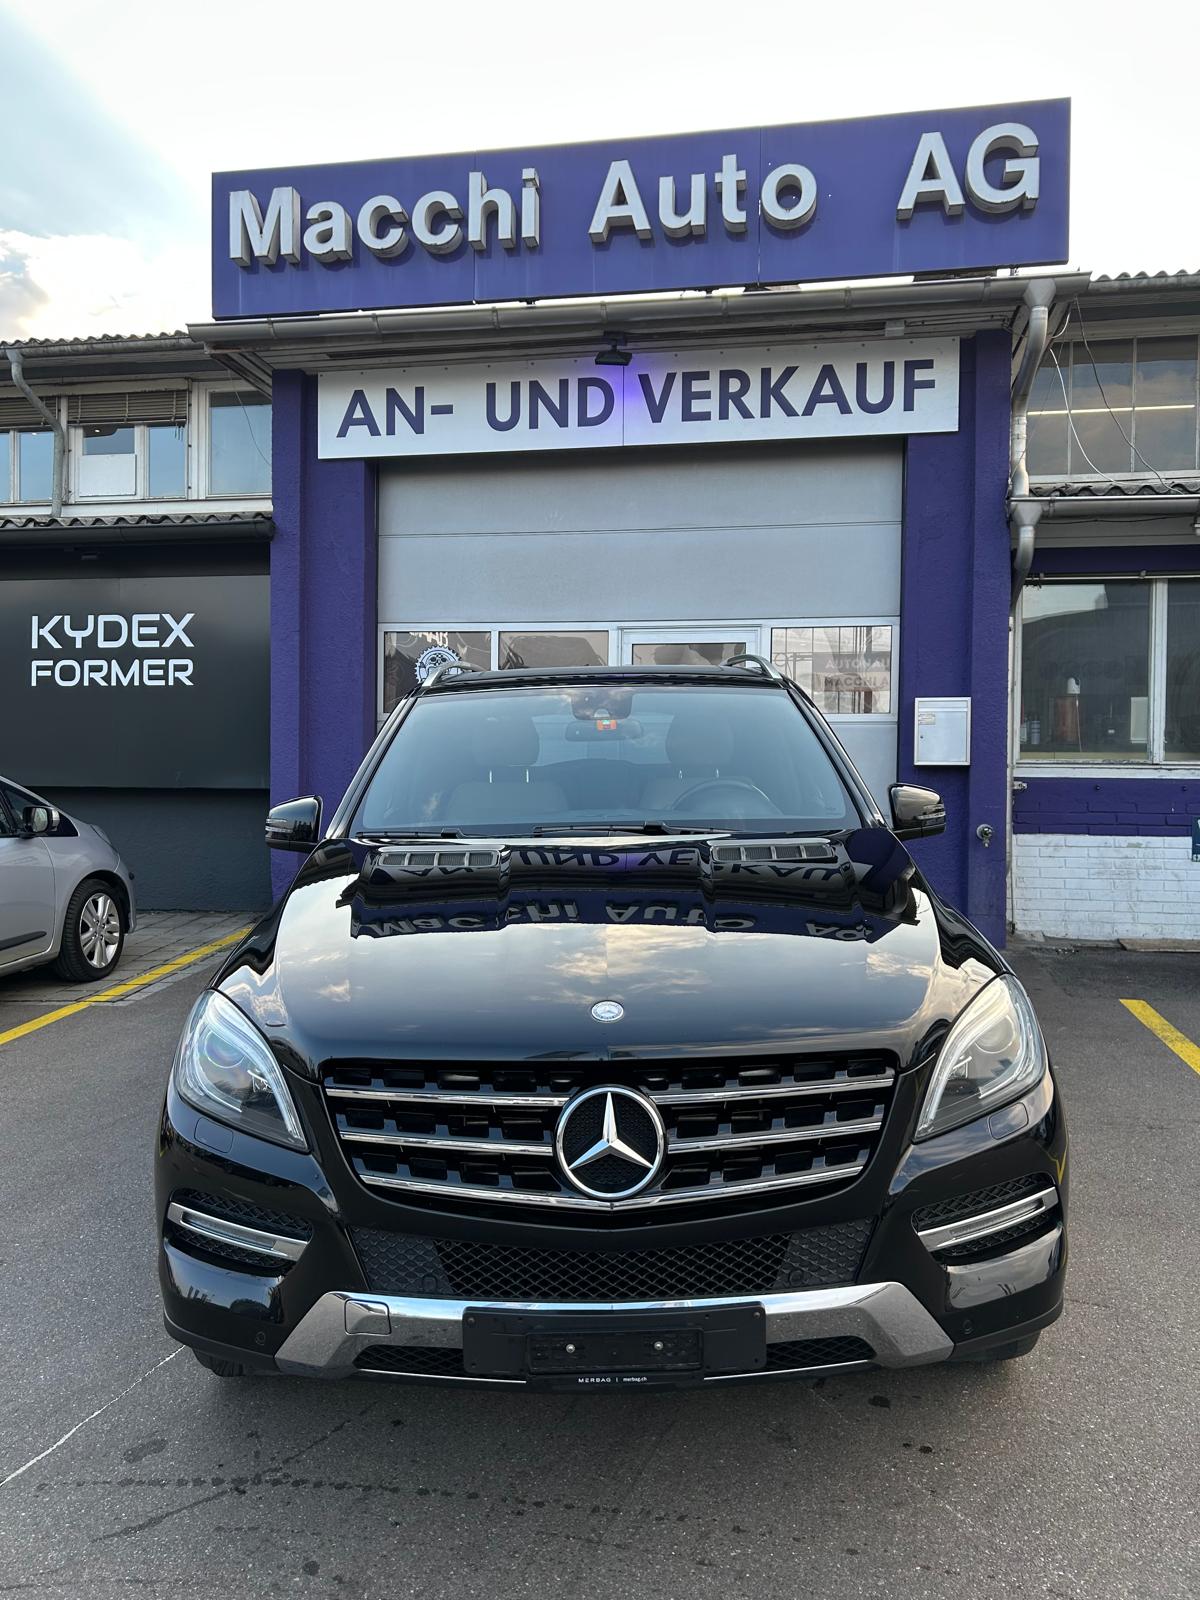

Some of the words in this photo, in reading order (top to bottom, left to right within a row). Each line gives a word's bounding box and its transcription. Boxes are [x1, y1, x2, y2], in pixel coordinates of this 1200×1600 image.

[228, 167, 540, 267] Macchi
[588, 154, 817, 243] Auto
[896, 122, 1040, 221] AG
[336, 385, 454, 438] AN-
[485, 376, 616, 432] UND
[638, 358, 937, 424] VERKAUF
[31, 613, 195, 649] KYDEX
[31, 658, 194, 687] FORMER
